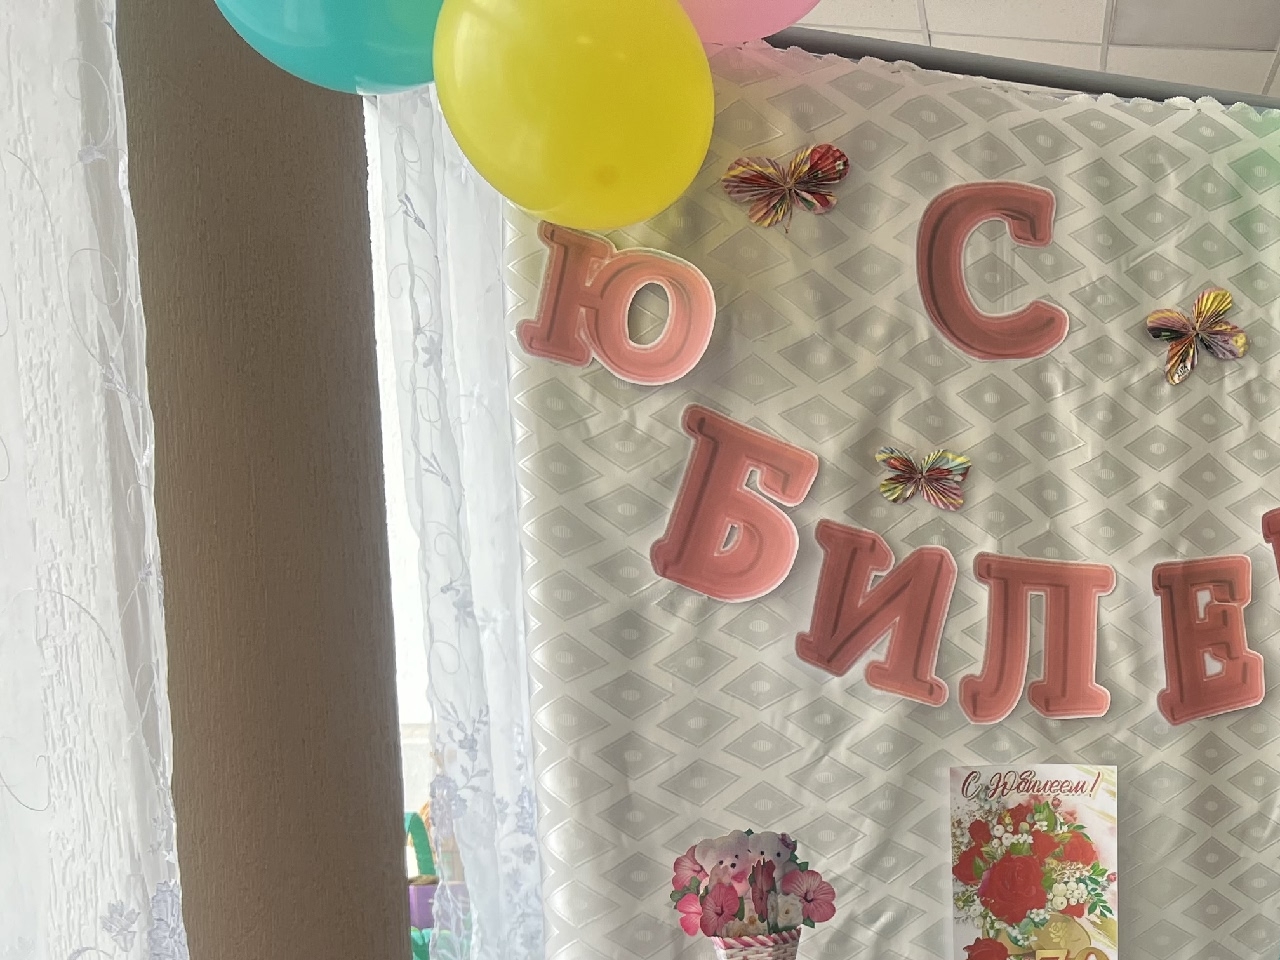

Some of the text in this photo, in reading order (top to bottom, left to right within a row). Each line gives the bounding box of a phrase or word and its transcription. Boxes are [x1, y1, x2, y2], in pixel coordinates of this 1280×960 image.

[917, 181, 1069, 361] С
[961, 770, 1102, 799] С Юбилеем!
